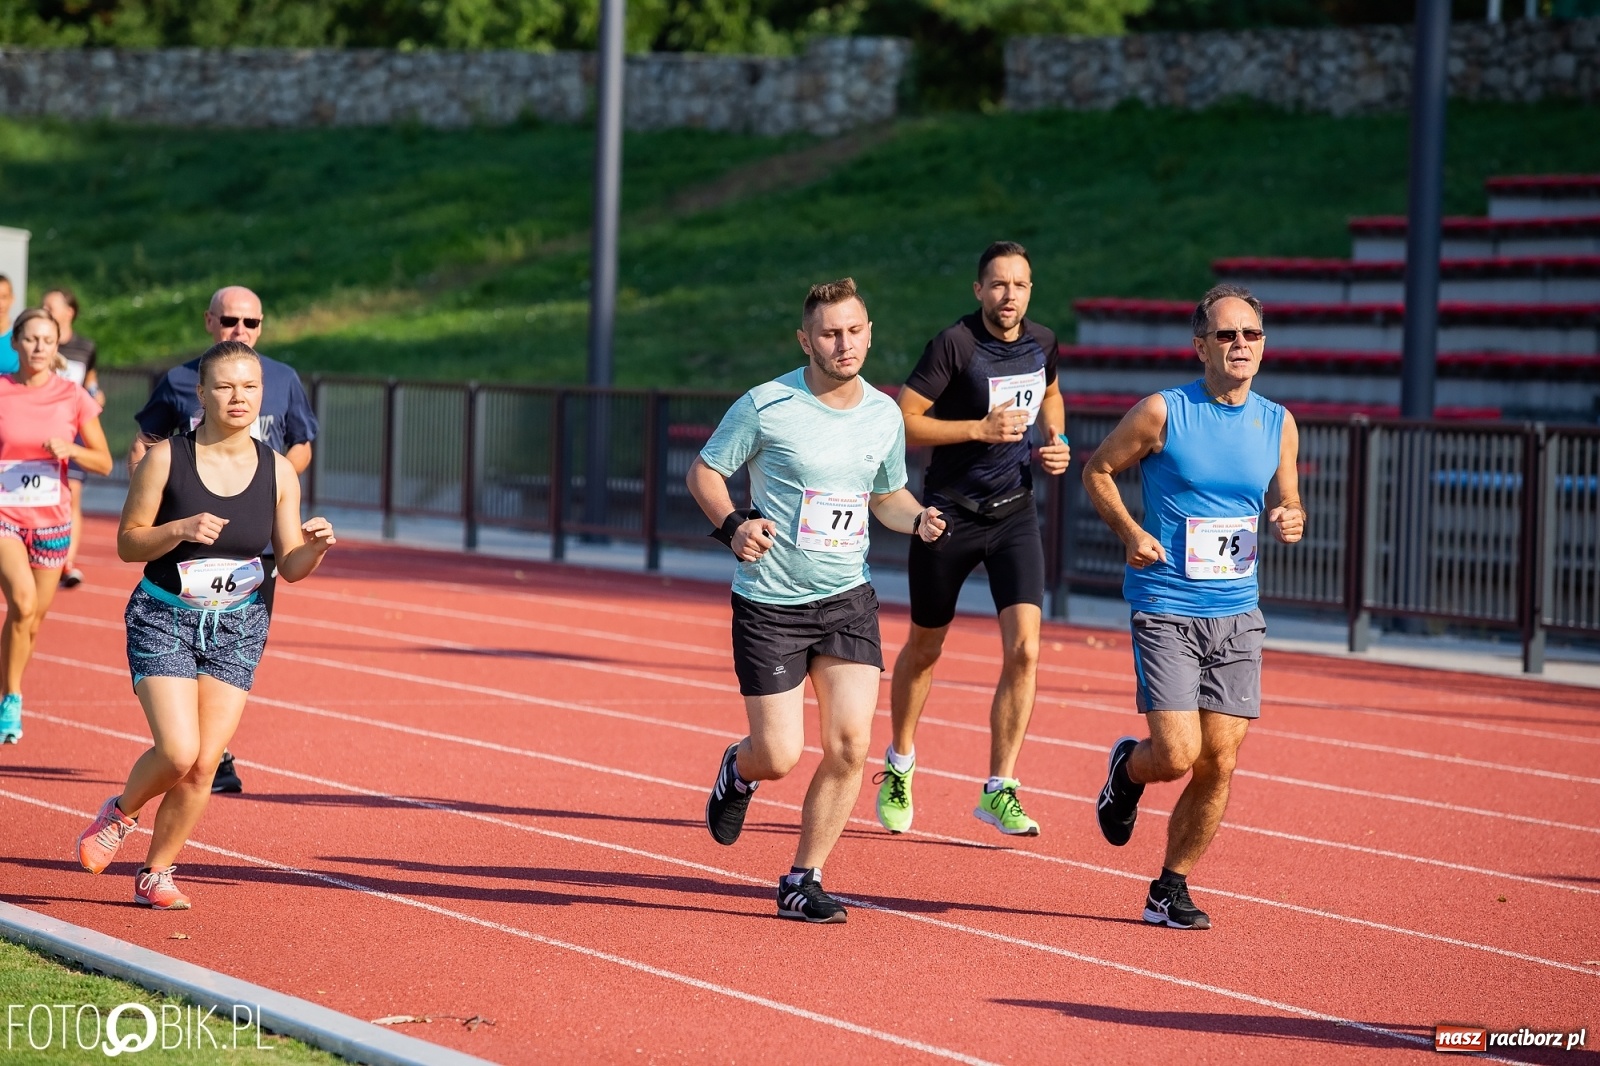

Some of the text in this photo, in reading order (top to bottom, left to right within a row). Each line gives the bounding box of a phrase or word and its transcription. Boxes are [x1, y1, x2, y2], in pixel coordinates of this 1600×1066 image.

[1015, 389, 1033, 407] 19
[21, 474, 41, 489] 90
[831, 509, 853, 531] 77
[1218, 535, 1240, 557] 75
[210, 573, 237, 594] 46
